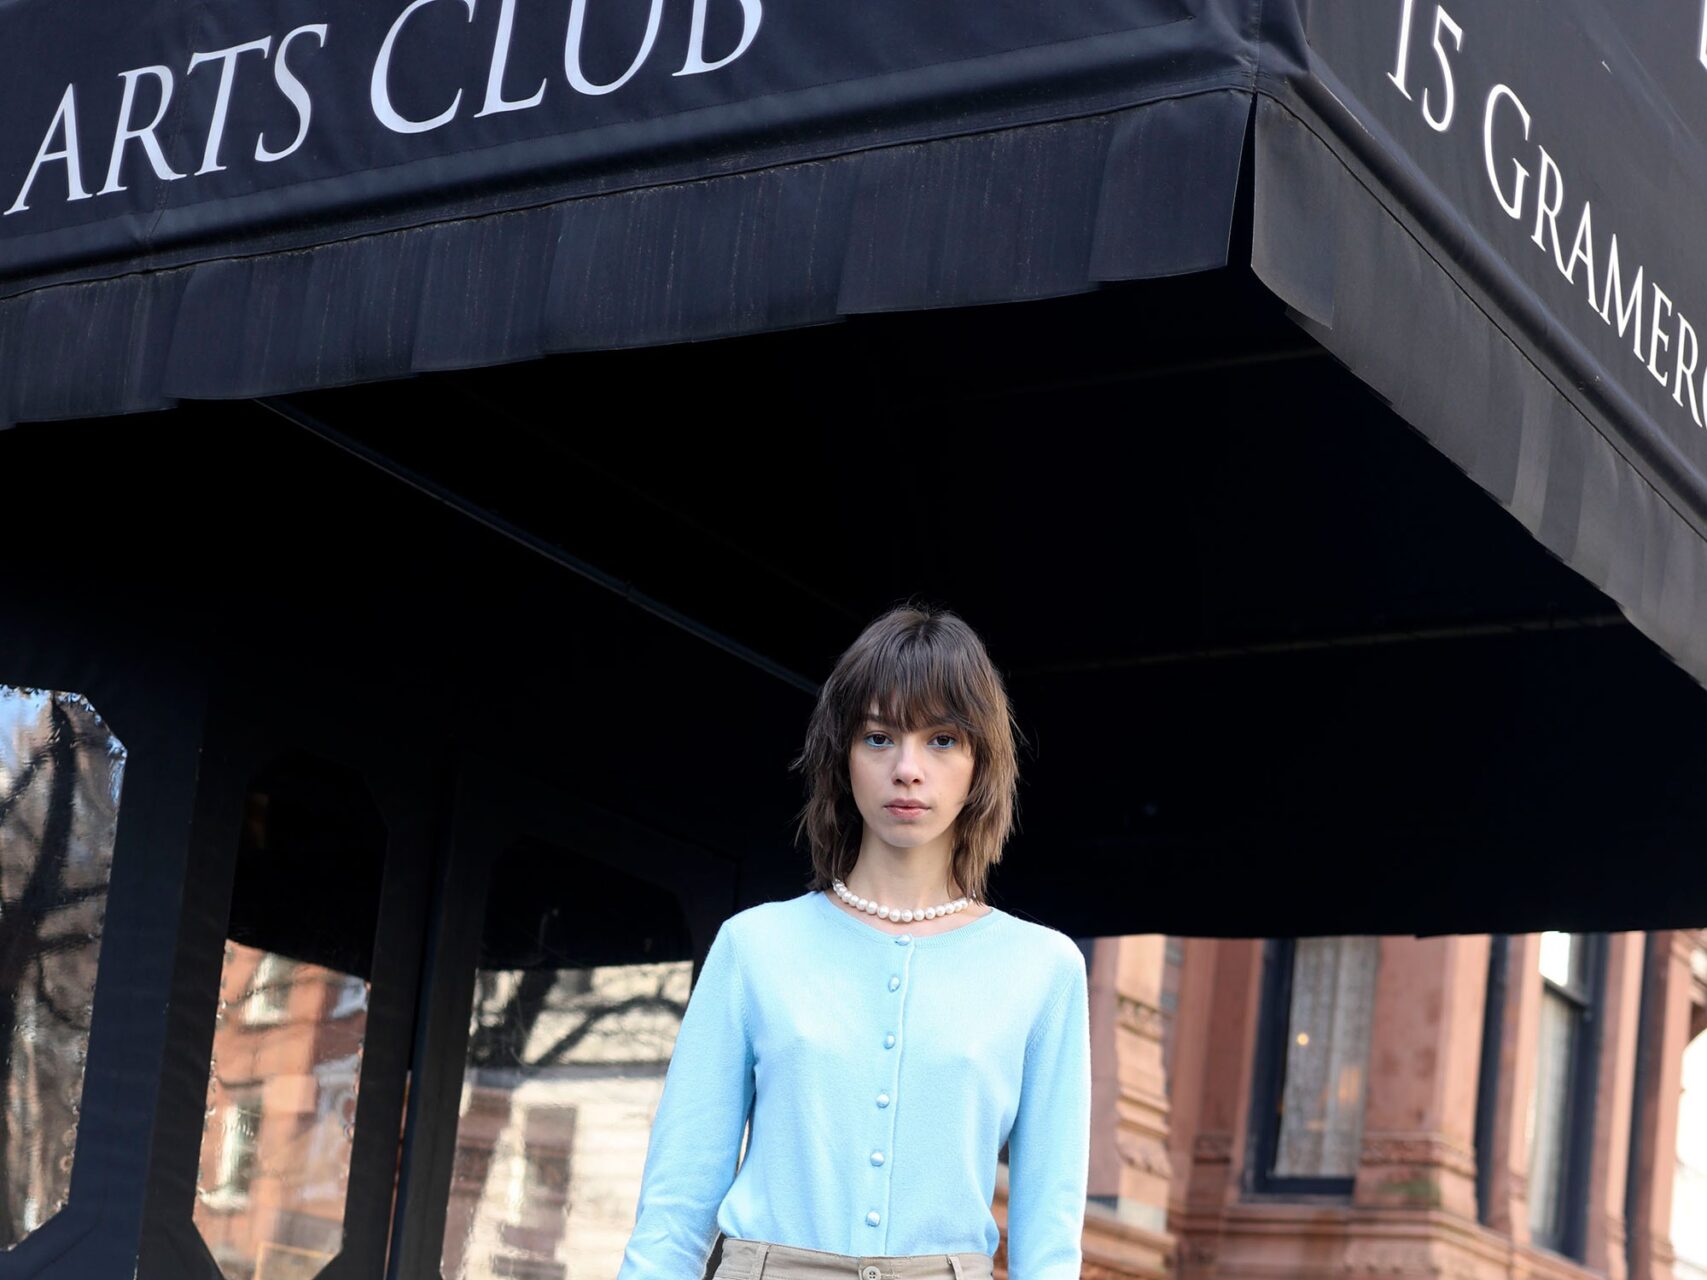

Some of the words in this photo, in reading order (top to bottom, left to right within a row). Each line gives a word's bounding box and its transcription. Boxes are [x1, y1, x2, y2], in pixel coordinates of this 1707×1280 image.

[3, 23, 328, 216] ARTS
[1386, 0, 1464, 133] 15
[1483, 83, 1707, 430] GRAMER
